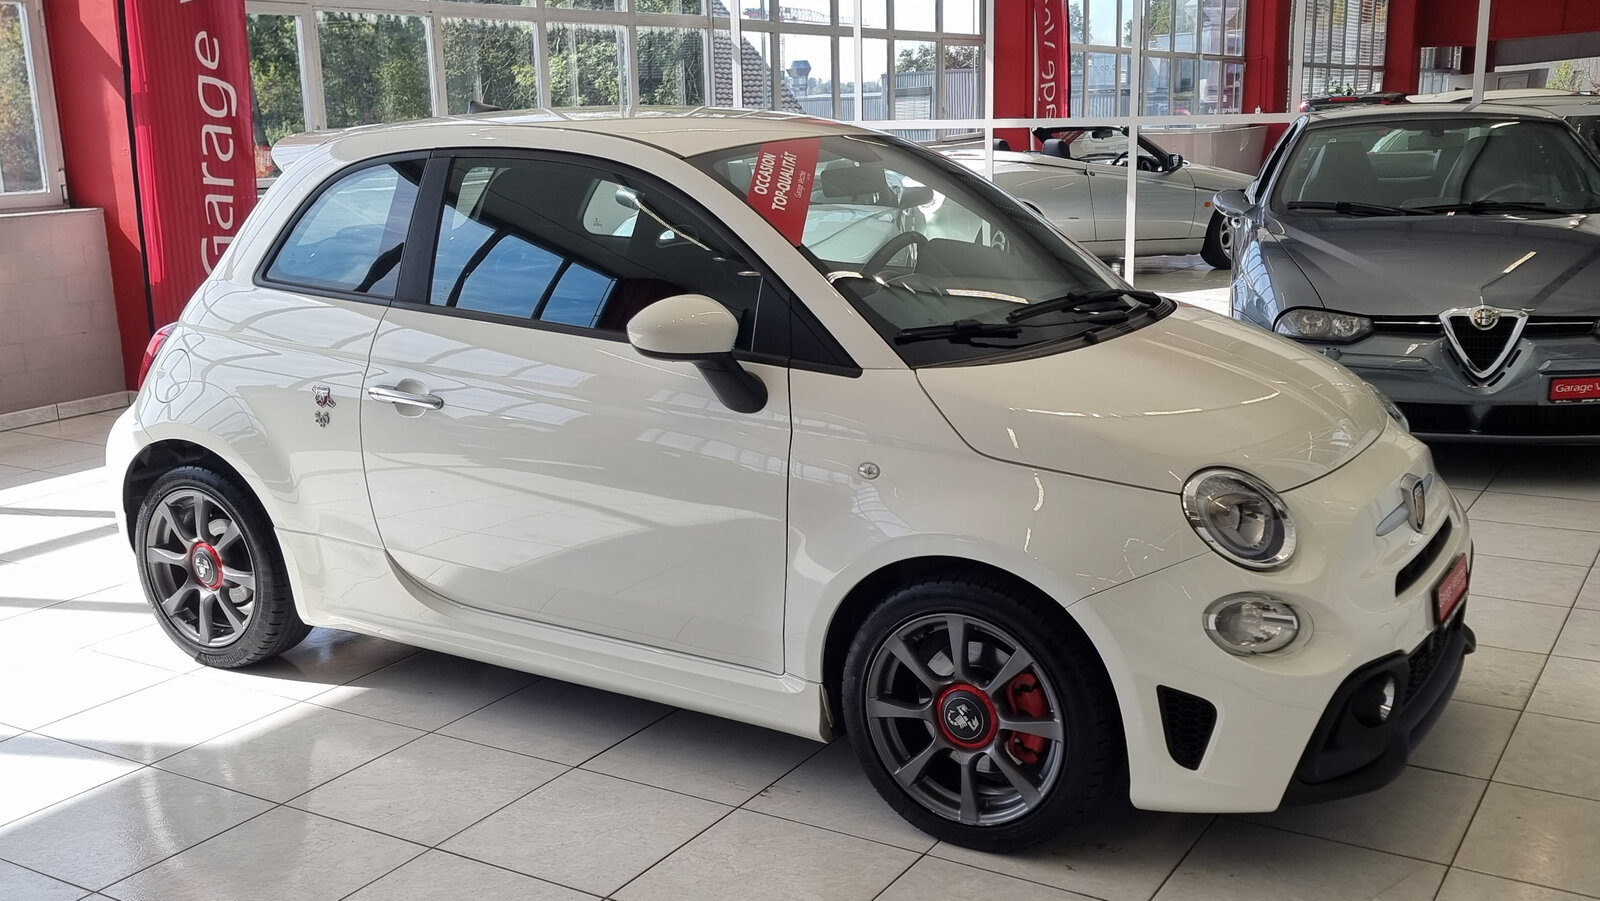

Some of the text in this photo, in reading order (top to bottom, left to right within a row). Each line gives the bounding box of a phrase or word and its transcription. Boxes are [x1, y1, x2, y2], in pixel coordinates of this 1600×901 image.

[753, 152, 777, 195] OCCASION
[771, 151, 797, 211] TOP-QUALITÄT
[1555, 384, 1593, 394] Garage
